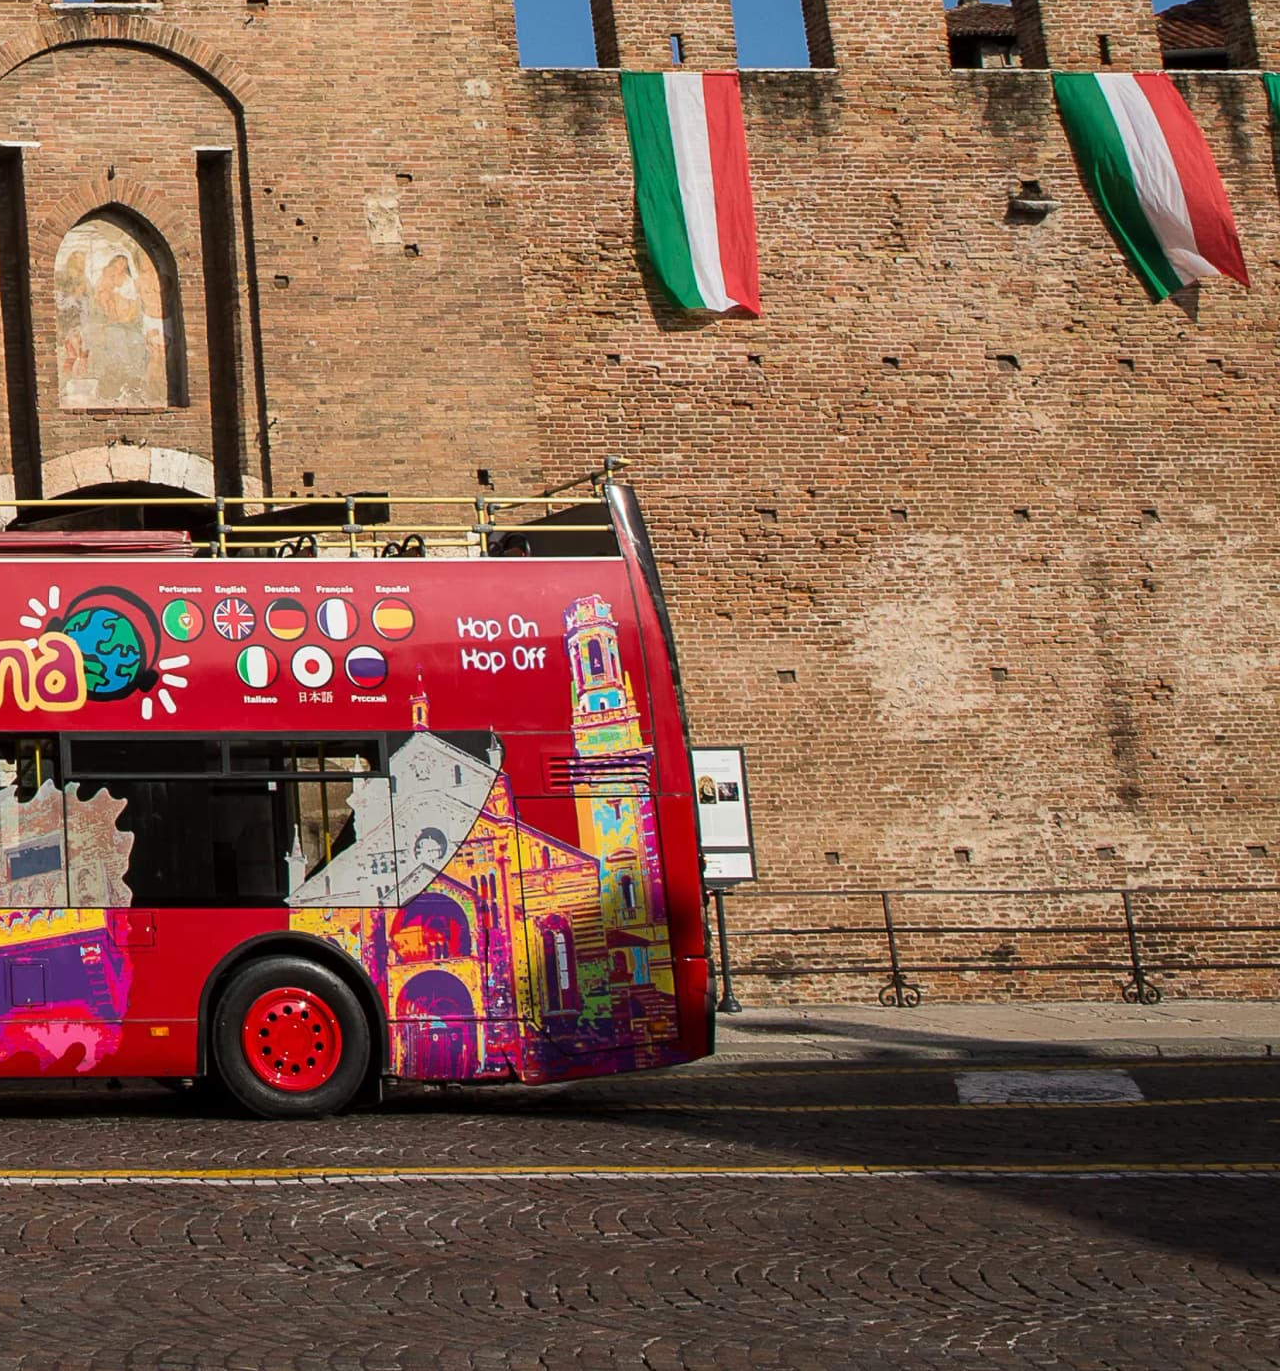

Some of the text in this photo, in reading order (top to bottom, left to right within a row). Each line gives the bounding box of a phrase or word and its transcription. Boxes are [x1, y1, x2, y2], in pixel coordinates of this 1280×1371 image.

[214, 585, 247, 595] English
[264, 585, 301, 594] Deutsch
[457, 613, 539, 642] Hop On
[461, 645, 546, 674] Hop Off
[243, 695, 278, 705] Italiano
[298, 691, 334, 704] 日本語
